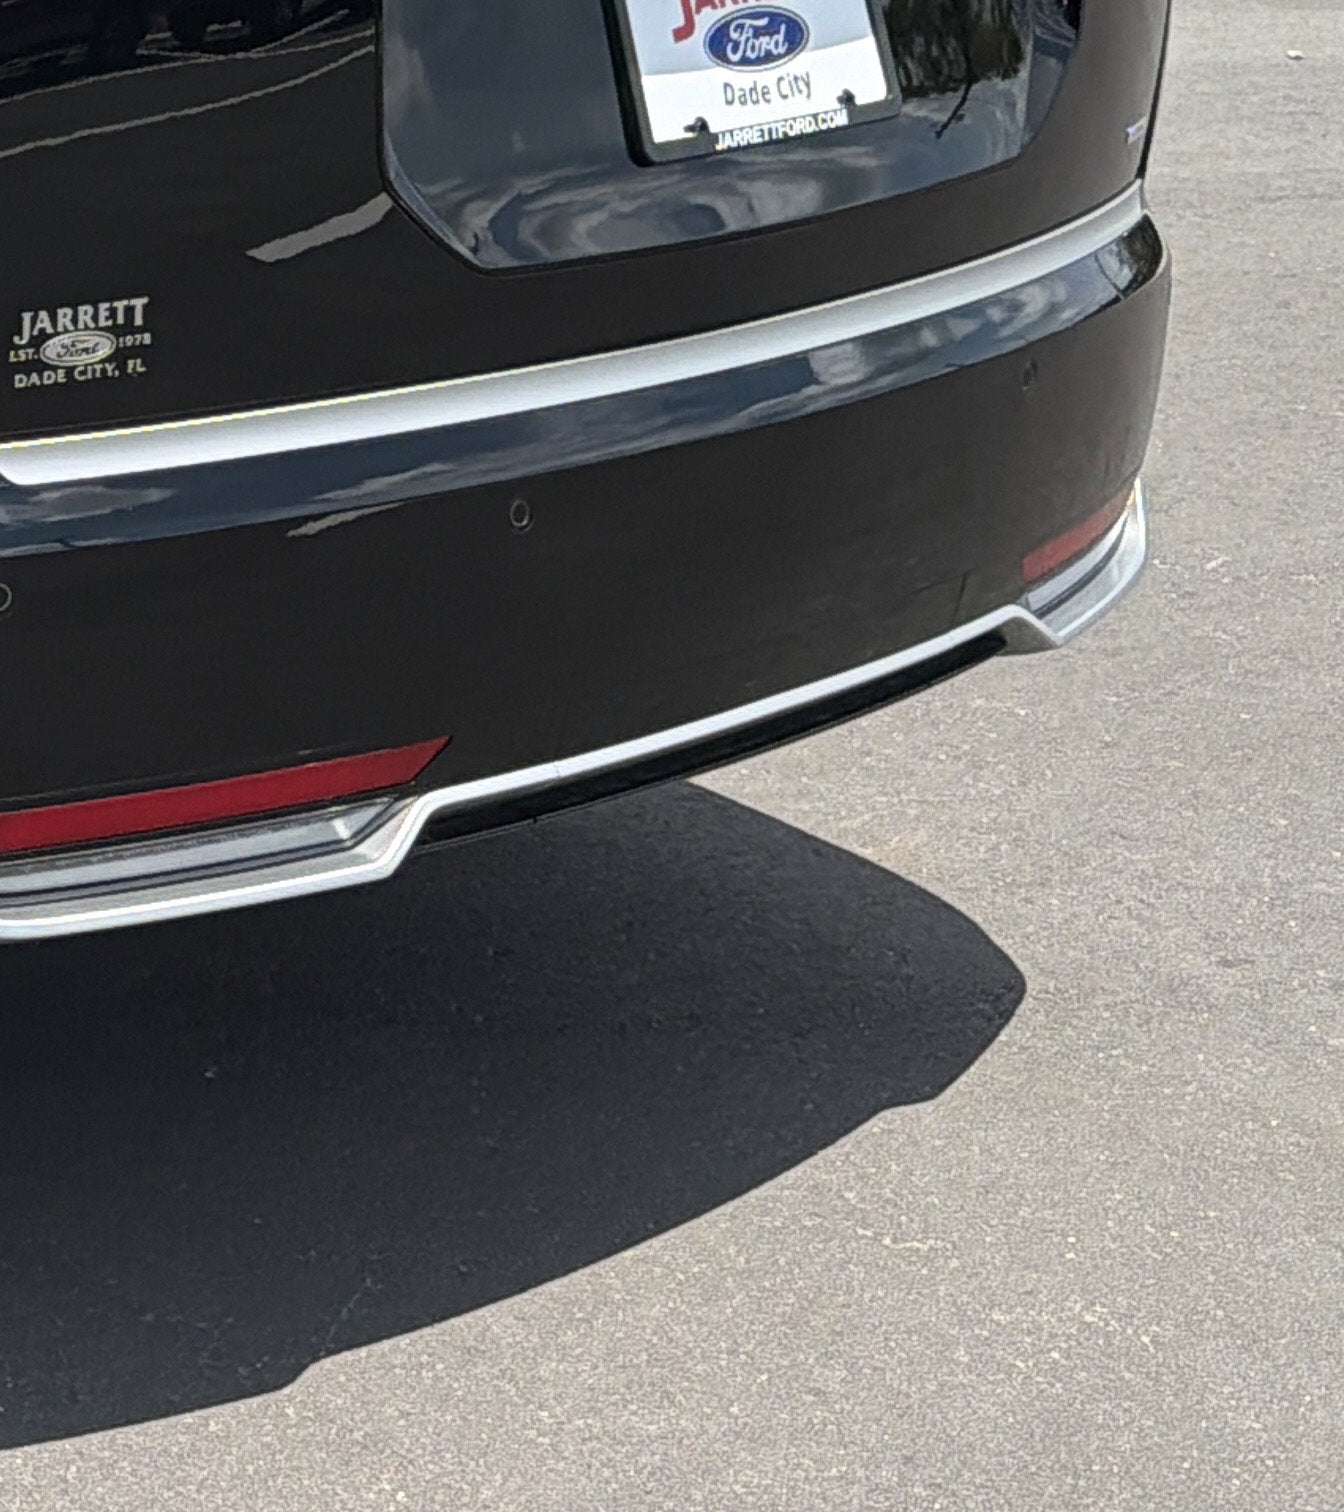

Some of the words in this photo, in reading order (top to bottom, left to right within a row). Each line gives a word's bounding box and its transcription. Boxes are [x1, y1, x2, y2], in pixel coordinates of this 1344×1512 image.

[725, 17, 788, 63] Ford
[723, 81, 771, 107] Dade
[778, 71, 813, 101] City
[715, 109, 848, 150] JARRETTFORD.COM
[13, 296, 150, 346] JARRETT
[55, 338, 101, 360] Ford
[14, 369, 66, 388] DADE
[74, 362, 120, 382] CITY,
[126, 359, 146, 373] FL
